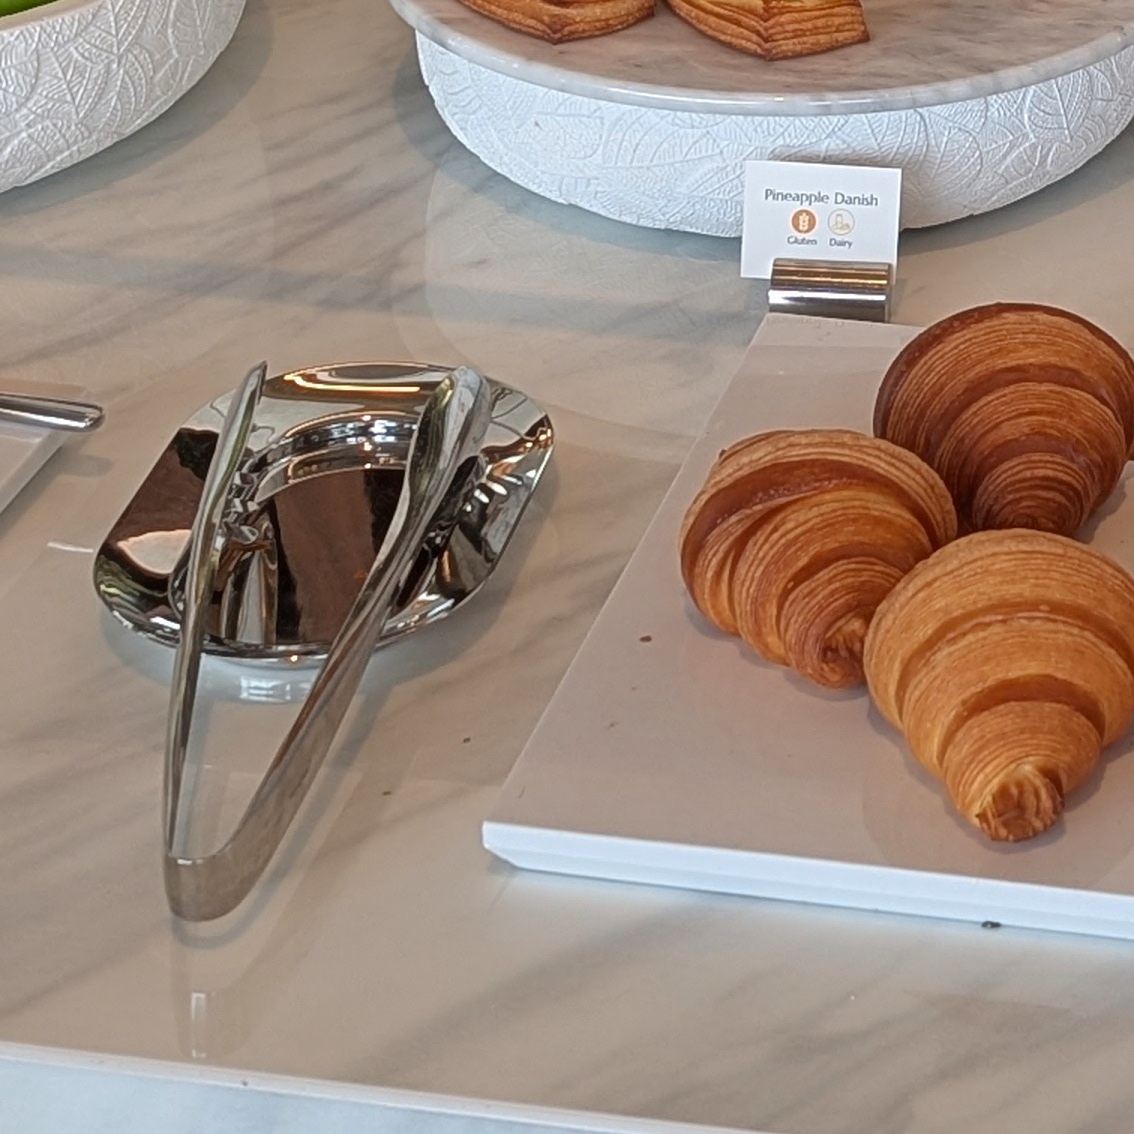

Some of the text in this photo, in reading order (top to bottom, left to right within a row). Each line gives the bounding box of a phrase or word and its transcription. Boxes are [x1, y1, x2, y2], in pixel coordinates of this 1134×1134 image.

[764, 188, 879, 207] Pineapple Danish
[786, 235, 853, 249] Gluten Dairy
